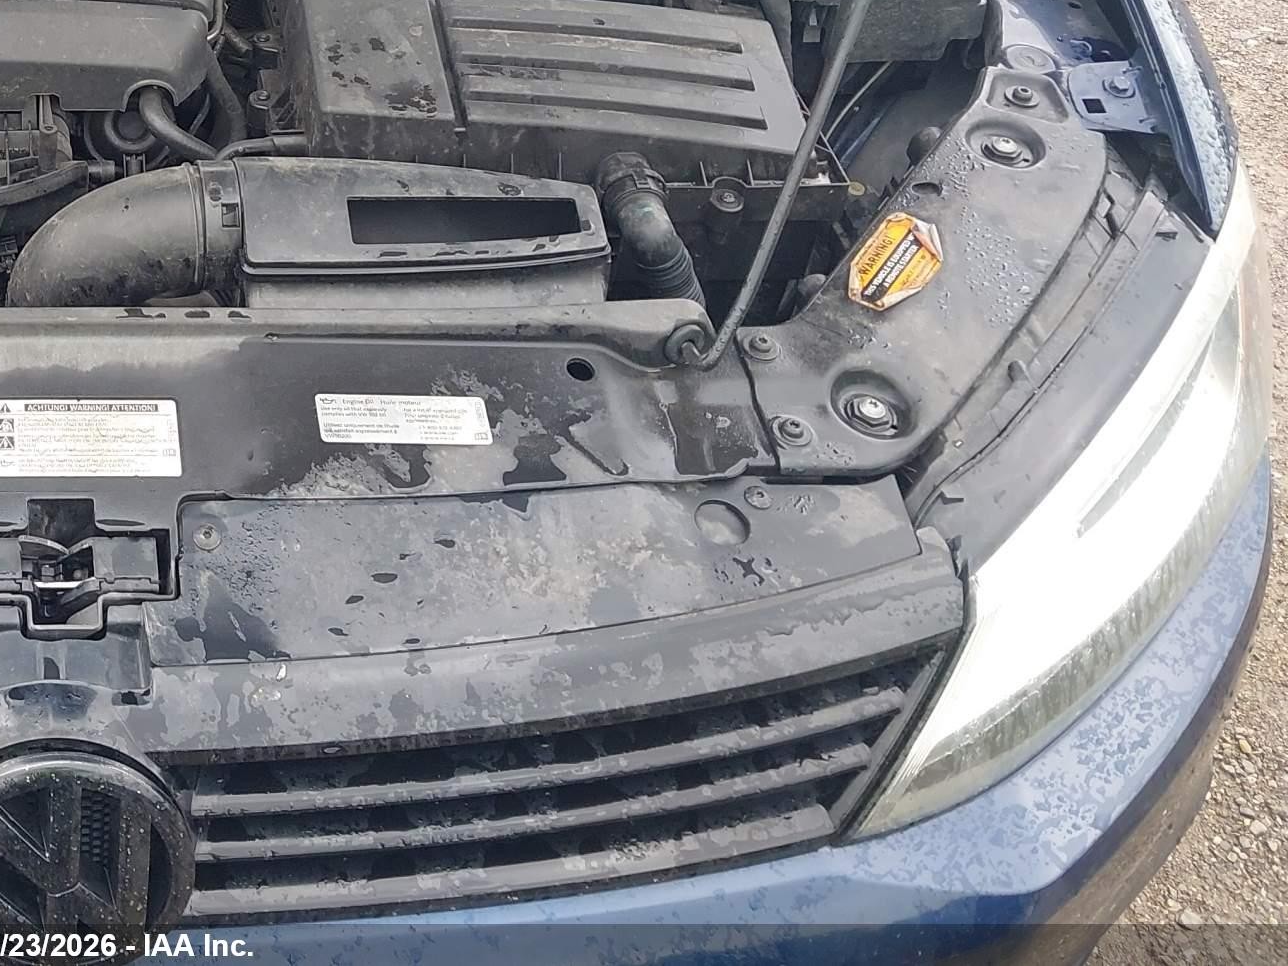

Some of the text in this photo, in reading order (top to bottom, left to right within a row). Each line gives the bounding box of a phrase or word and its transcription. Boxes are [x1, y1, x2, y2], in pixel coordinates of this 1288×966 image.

[858, 235, 896, 275] WARNING!
[69, 403, 110, 412] WARNING!
[111, 403, 156, 412] ATTENTION!
